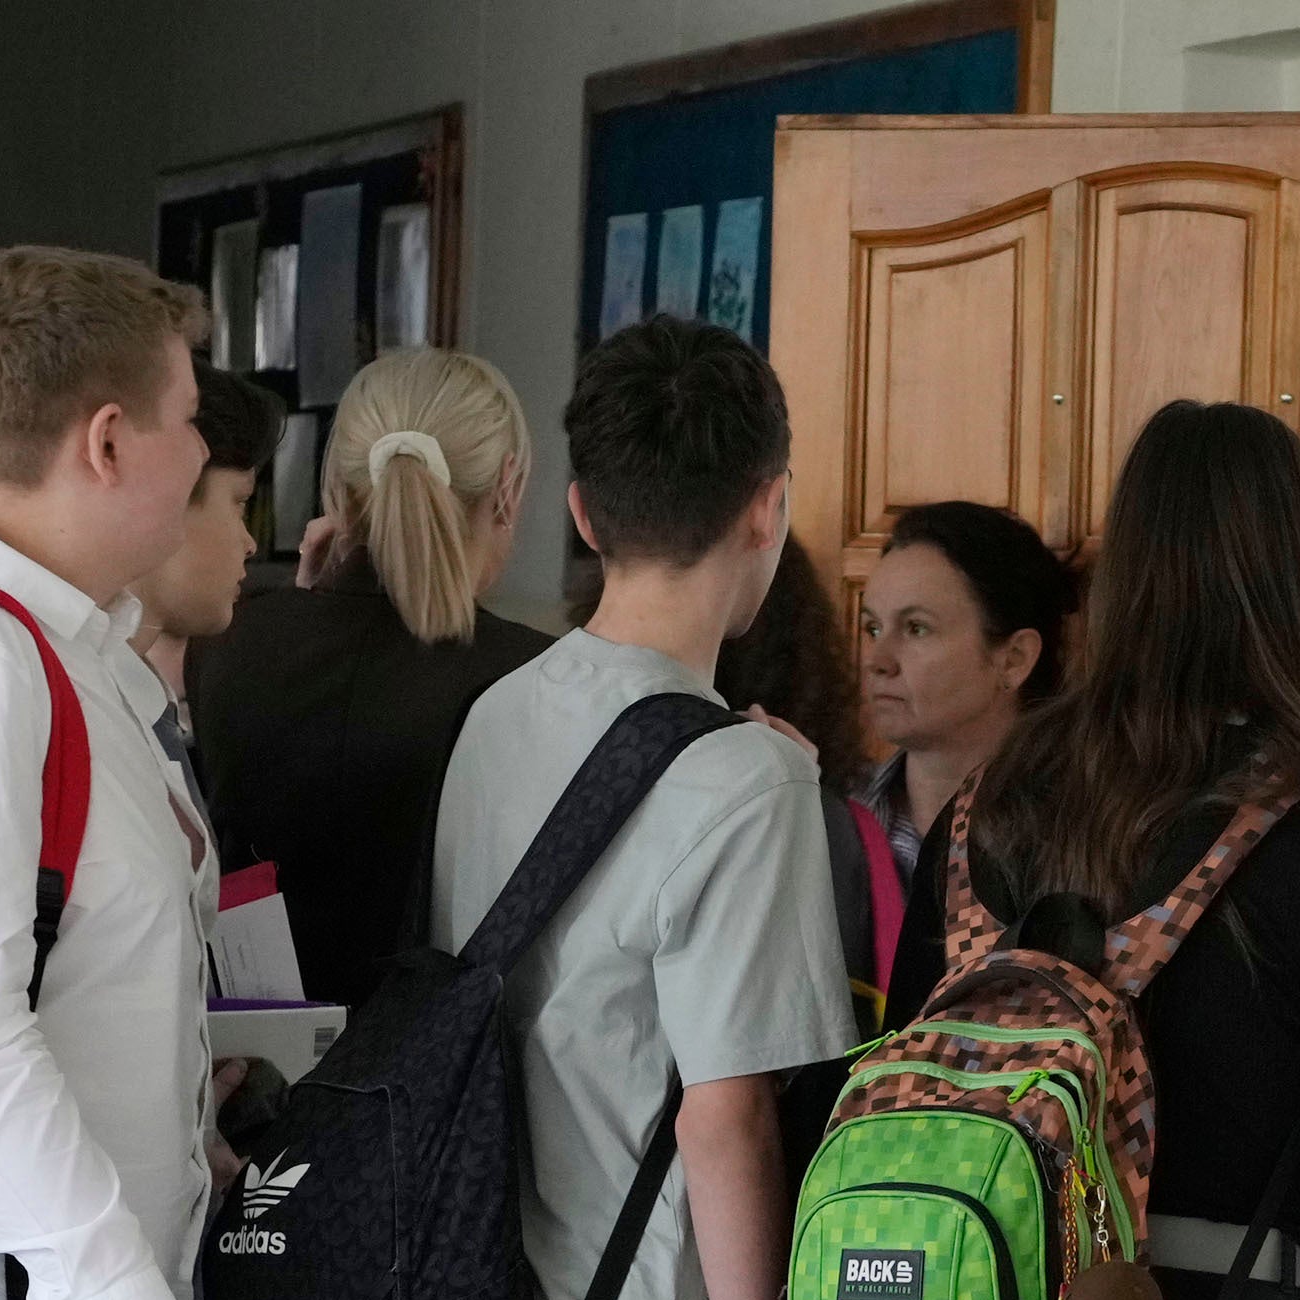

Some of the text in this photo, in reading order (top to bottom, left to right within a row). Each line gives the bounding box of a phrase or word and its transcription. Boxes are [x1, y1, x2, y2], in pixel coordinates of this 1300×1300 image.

[219, 1224, 287, 1256] adidas
[846, 1259, 913, 1284] BACK UP
